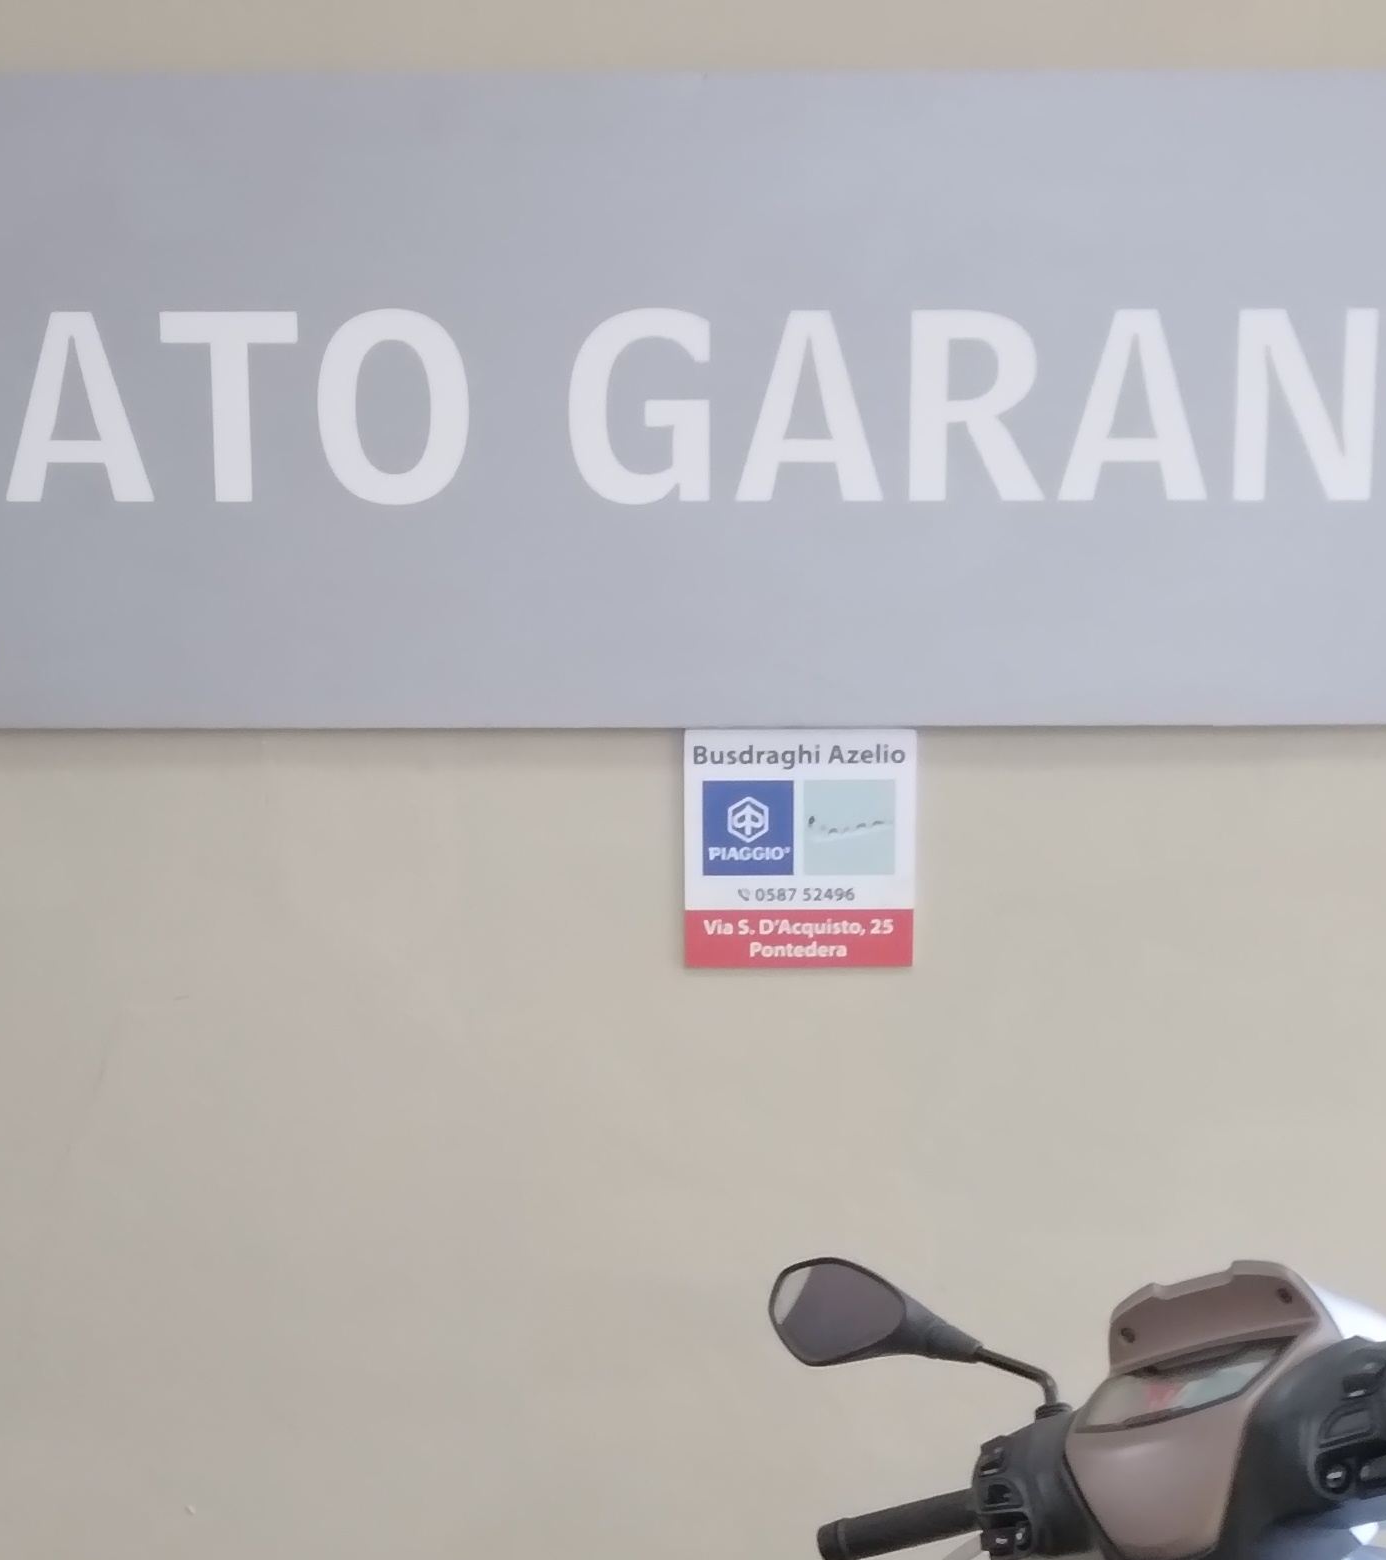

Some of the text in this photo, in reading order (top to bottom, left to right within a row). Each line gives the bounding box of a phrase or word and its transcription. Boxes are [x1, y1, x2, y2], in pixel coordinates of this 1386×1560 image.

[693, 744, 906, 770] Busdraghi Azelio
[708, 847, 785, 861] PIAGGIO
[755, 888, 856, 902] 0587 52496
[703, 919, 894, 938] Via S. D'Acquisto, 25
[749, 942, 848, 958] Pontedera
